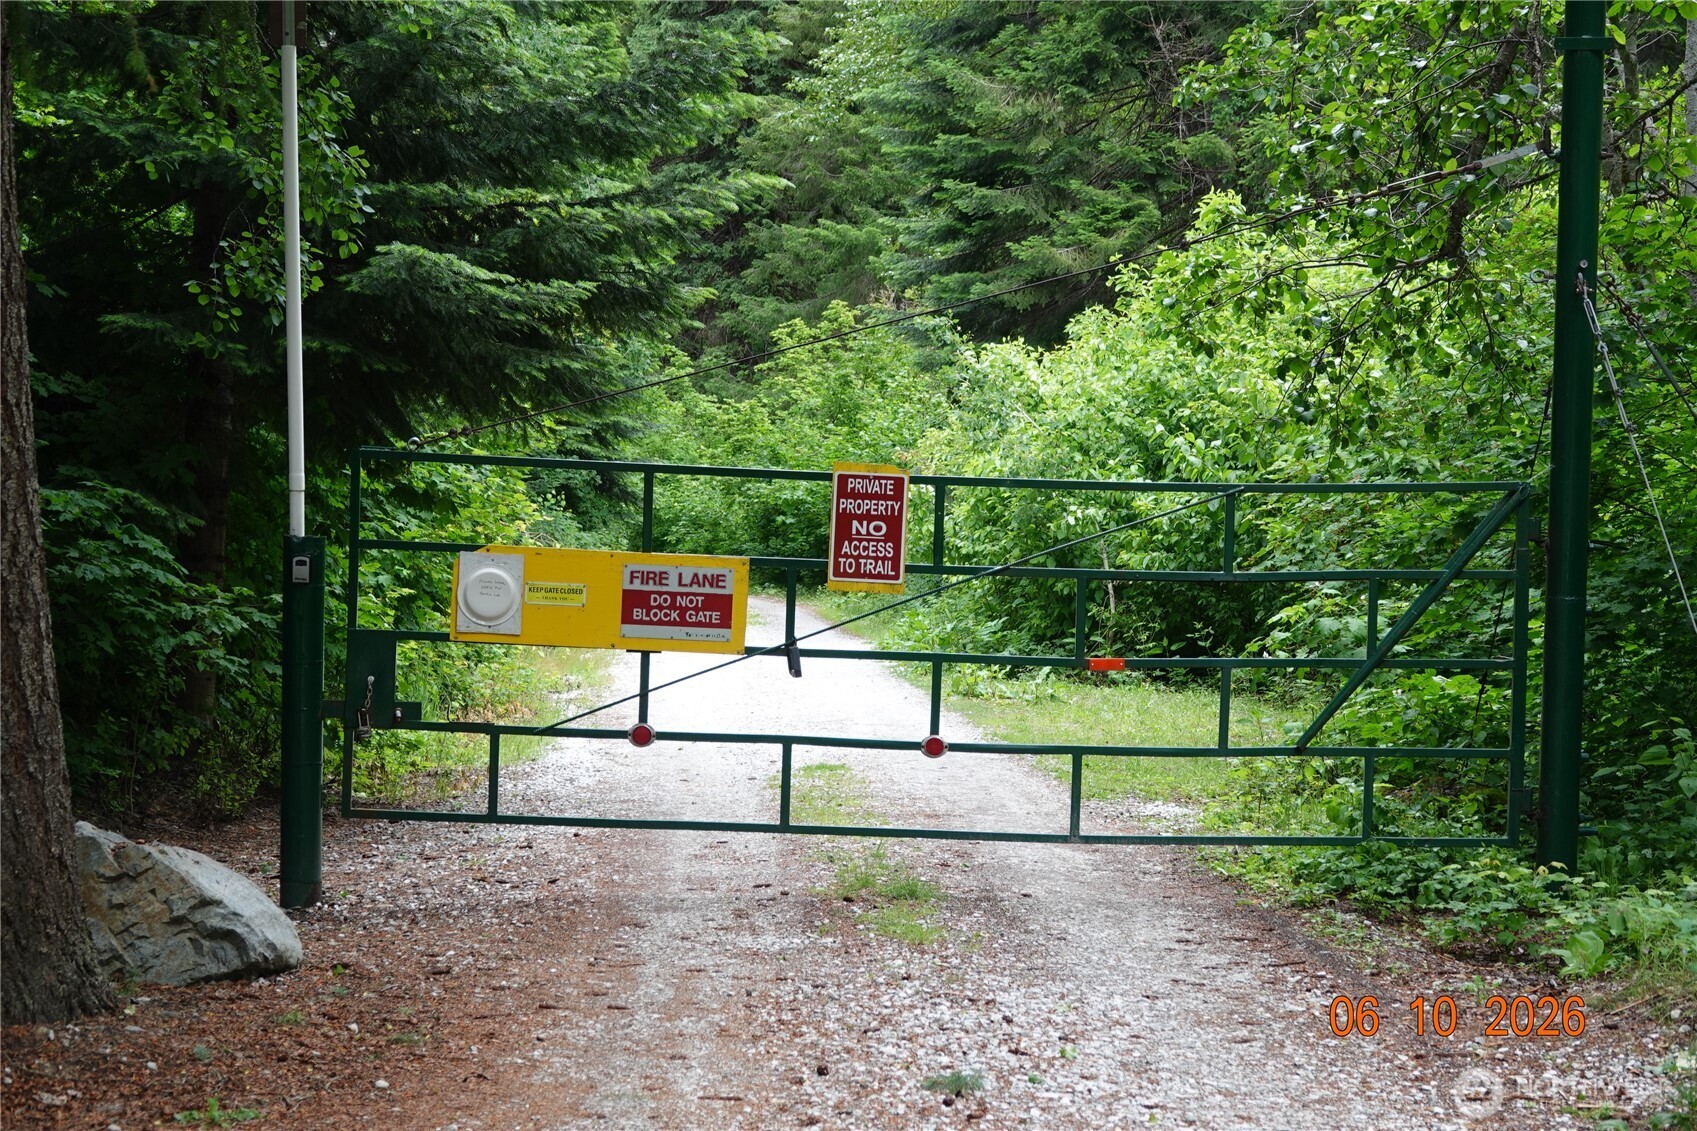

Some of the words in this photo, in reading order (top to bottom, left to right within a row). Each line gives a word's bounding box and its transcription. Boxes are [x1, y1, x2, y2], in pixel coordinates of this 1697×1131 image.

[848, 478, 894, 495] PRIVATE
[839, 498, 900, 516] PROPERTY
[852, 520, 887, 536] NO
[841, 540, 894, 558] ACCESS
[838, 558, 856, 574] TO
[858, 559, 896, 576] TRAIL
[628, 570, 670, 586] FIRE
[677, 572, 727, 589] LANE
[650, 594, 671, 606] DO
[676, 595, 704, 608] NOT
[632, 608, 680, 622] BLOCK
[685, 610, 721, 624] GATE
